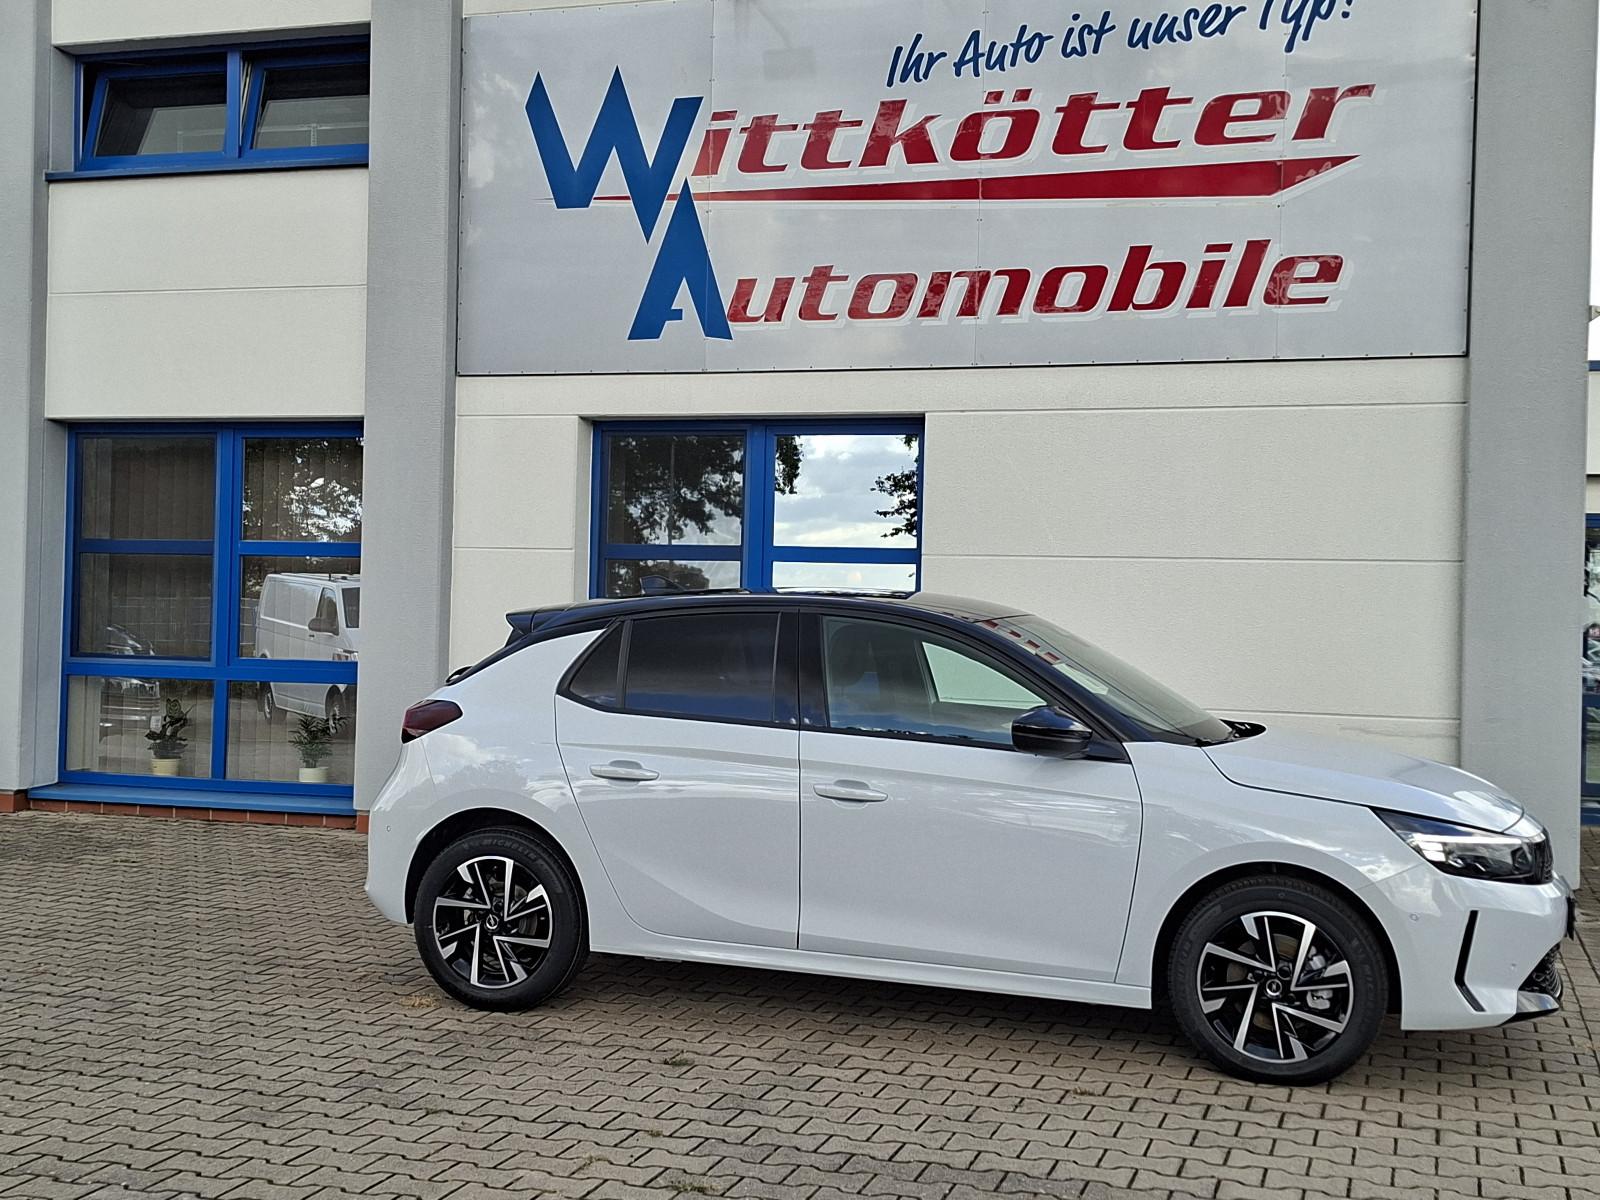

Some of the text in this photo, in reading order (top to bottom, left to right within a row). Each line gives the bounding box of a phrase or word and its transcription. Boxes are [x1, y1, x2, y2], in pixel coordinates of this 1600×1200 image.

[886, 35, 947, 88] Ihr
[953, 25, 1053, 79] Auto
[1061, 12, 1116, 58] ist
[1127, 3, 1246, 49] unser
[524, 66, 1376, 241] Wittkötter
[627, 178, 1344, 341] Automobile
